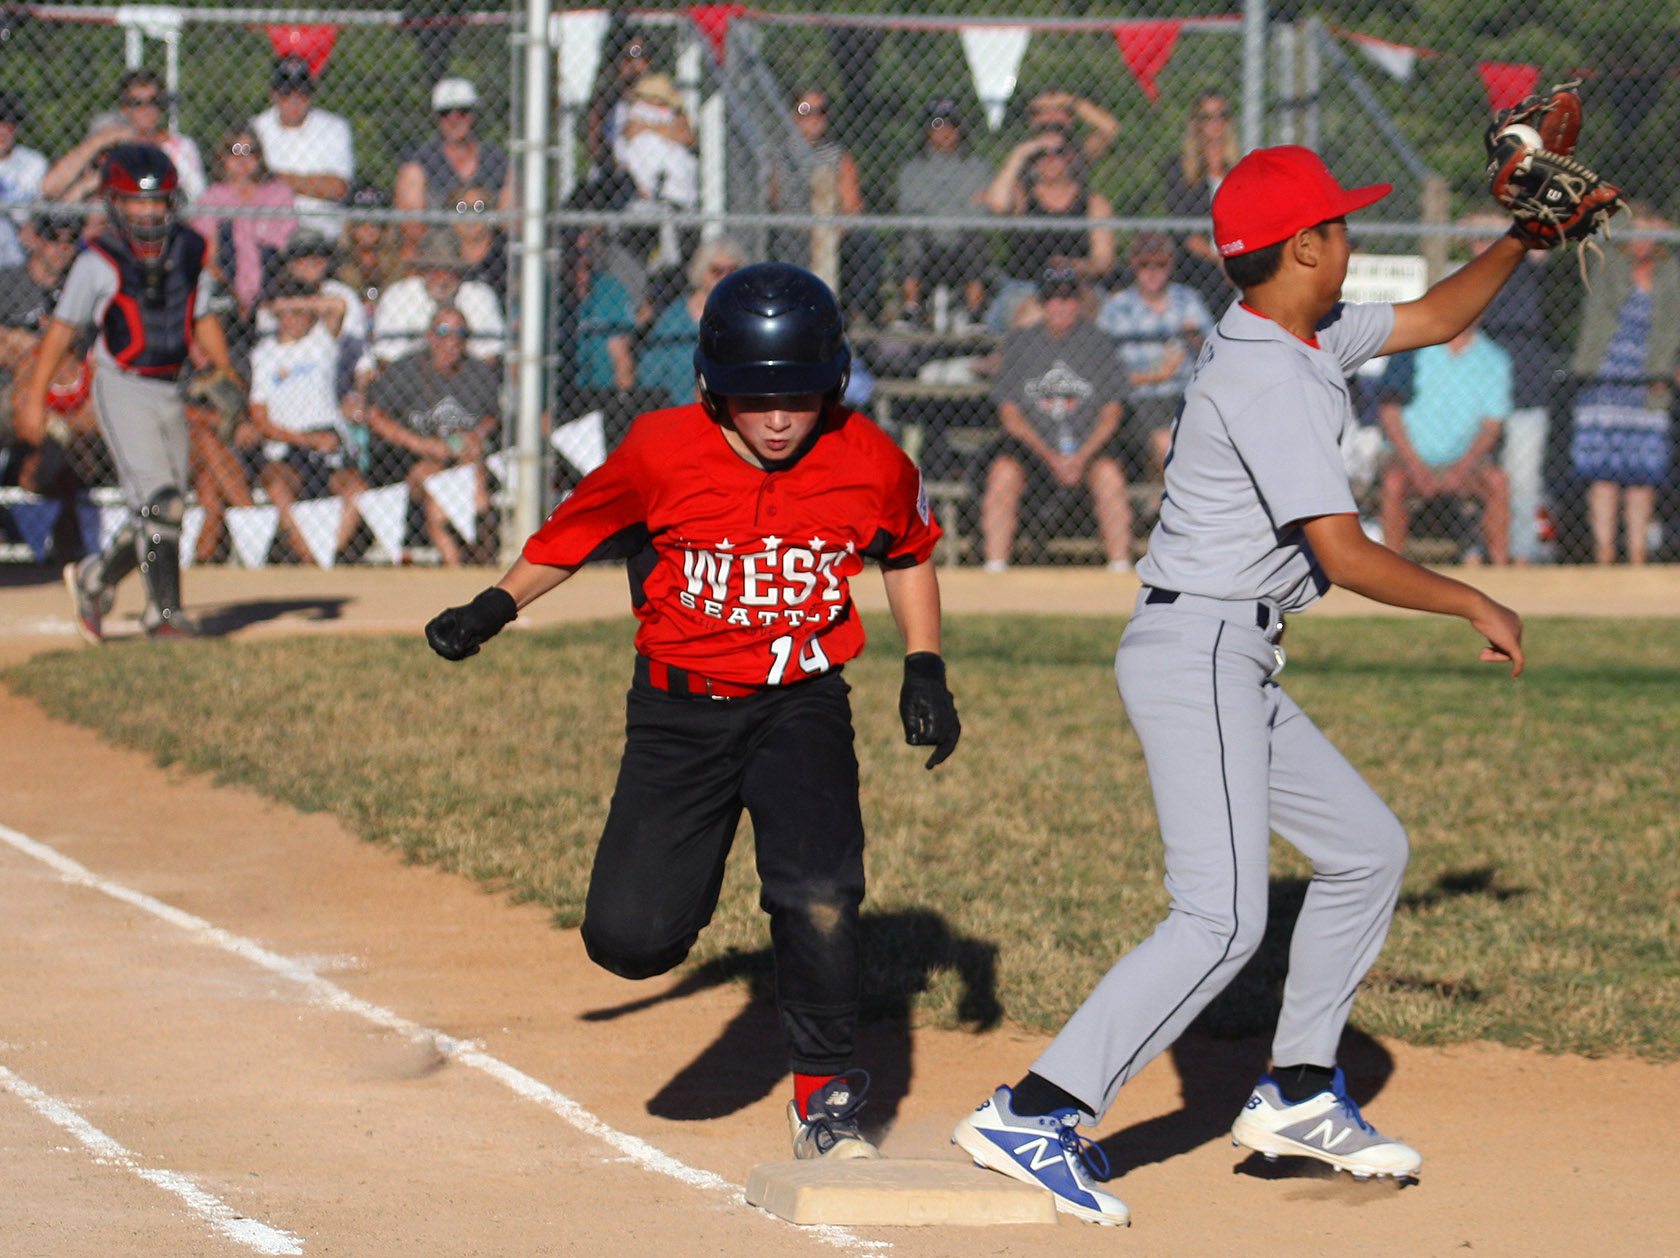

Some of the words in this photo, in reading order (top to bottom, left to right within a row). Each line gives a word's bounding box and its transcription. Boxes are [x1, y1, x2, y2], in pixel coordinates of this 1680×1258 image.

[683, 547, 848, 606] WEST
[767, 632, 830, 685] 14
[1013, 1137, 1065, 1171] N
[1302, 1118, 1353, 1150] N
